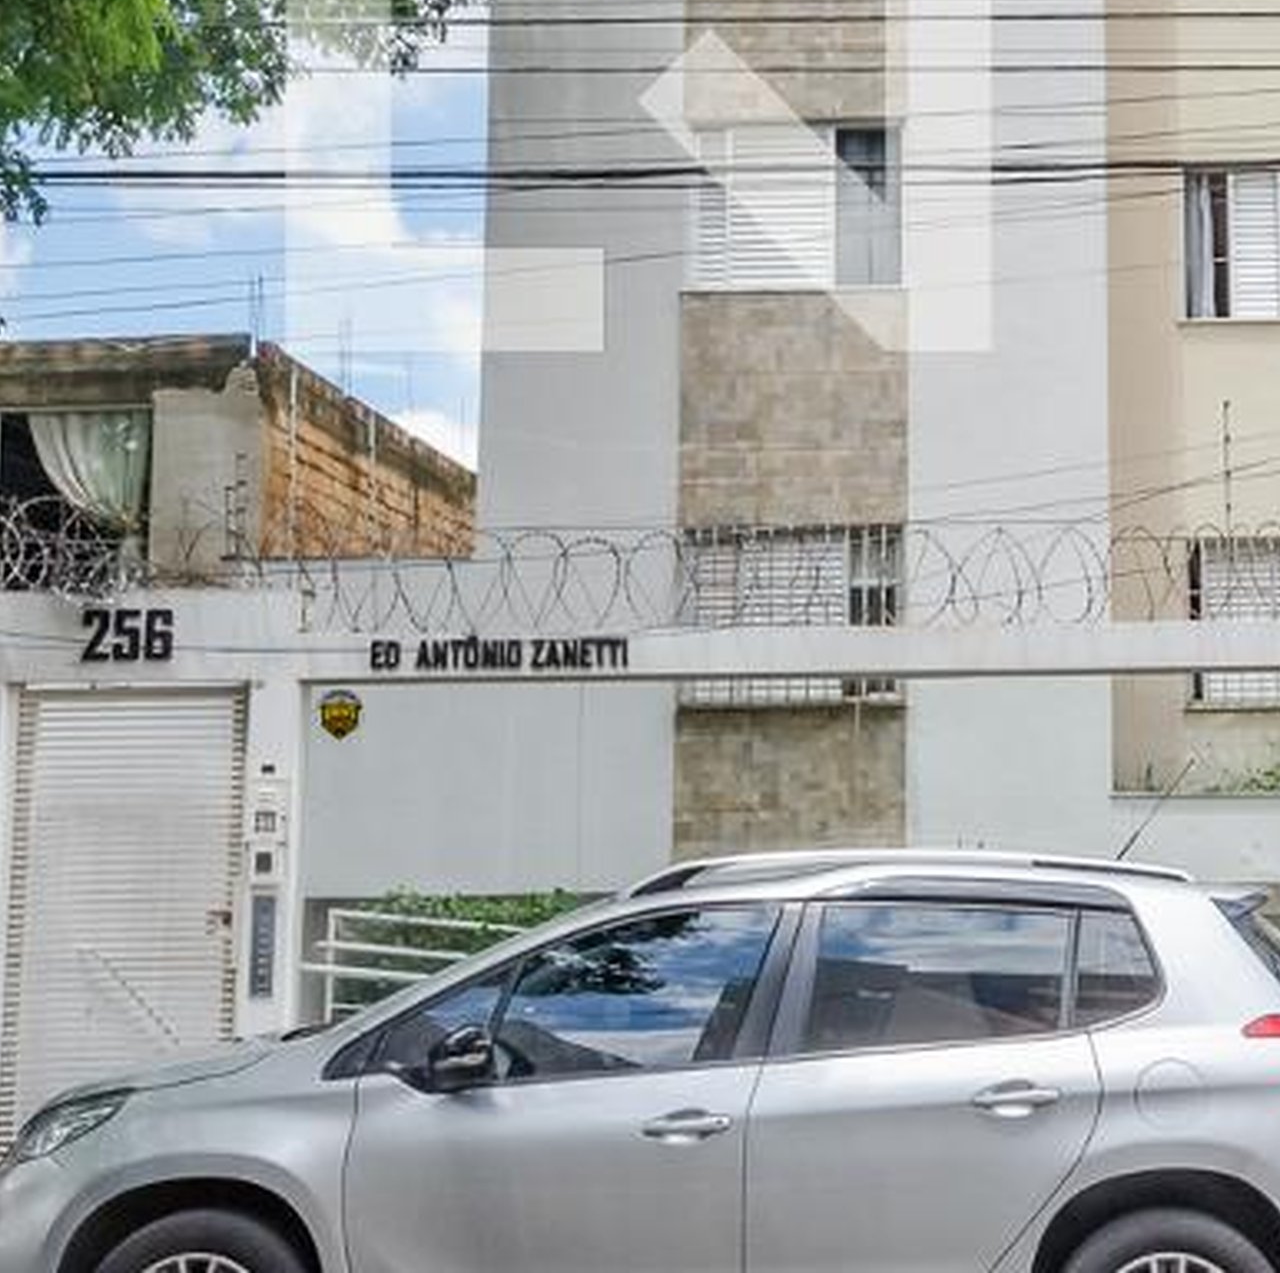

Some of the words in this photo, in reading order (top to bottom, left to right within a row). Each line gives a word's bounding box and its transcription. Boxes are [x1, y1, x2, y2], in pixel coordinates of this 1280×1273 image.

[82, 609, 173, 661] 256
[415, 635, 522, 669] ANTÔNIO
[530, 637, 628, 669] ZANETTI
